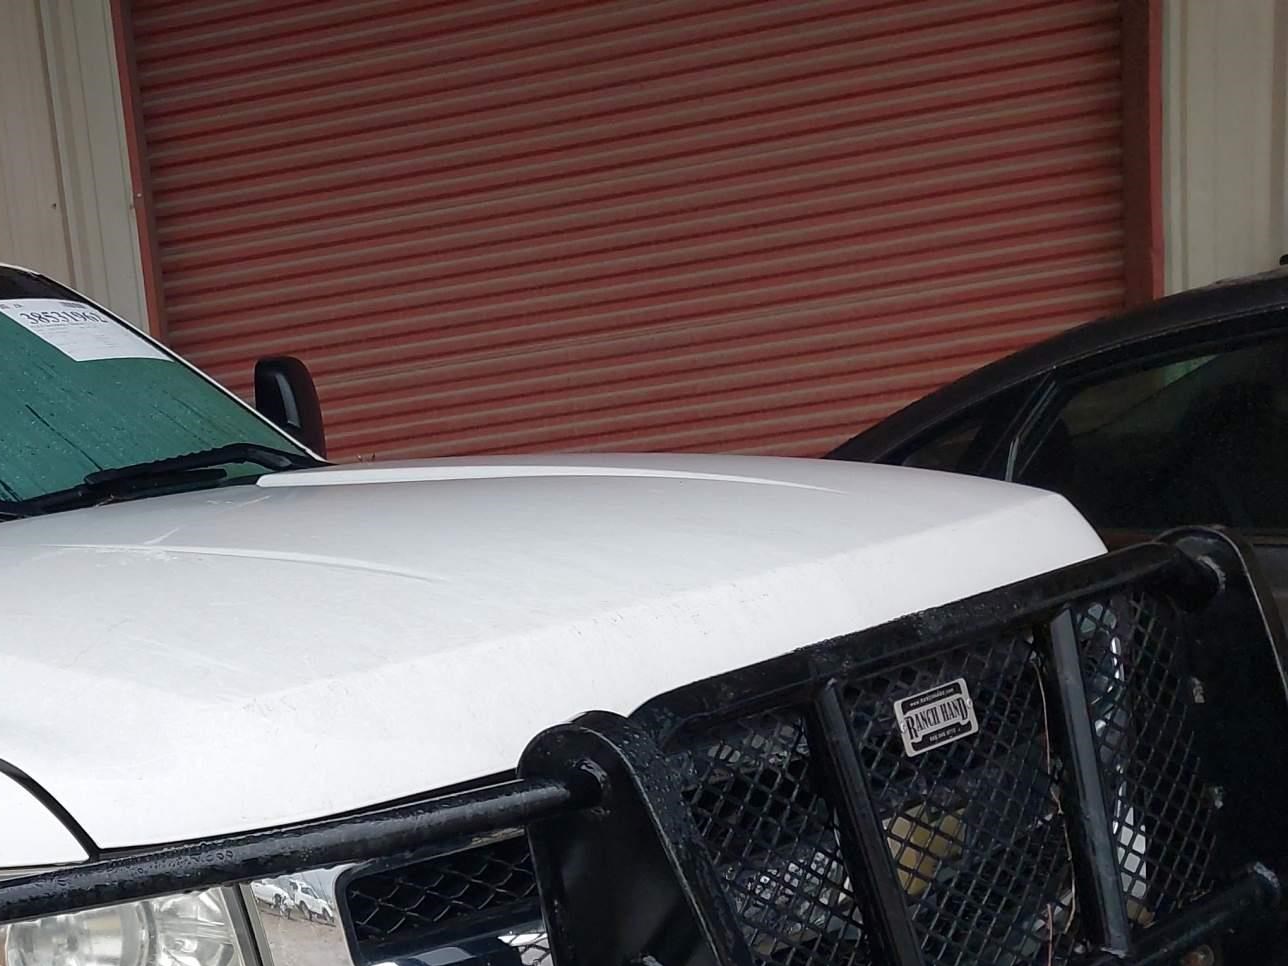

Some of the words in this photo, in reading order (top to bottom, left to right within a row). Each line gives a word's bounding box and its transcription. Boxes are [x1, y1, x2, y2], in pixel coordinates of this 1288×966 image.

[19, 311, 108, 325] 38531962
[904, 706, 941, 740] RANCH
[940, 697, 969, 722] HAND
